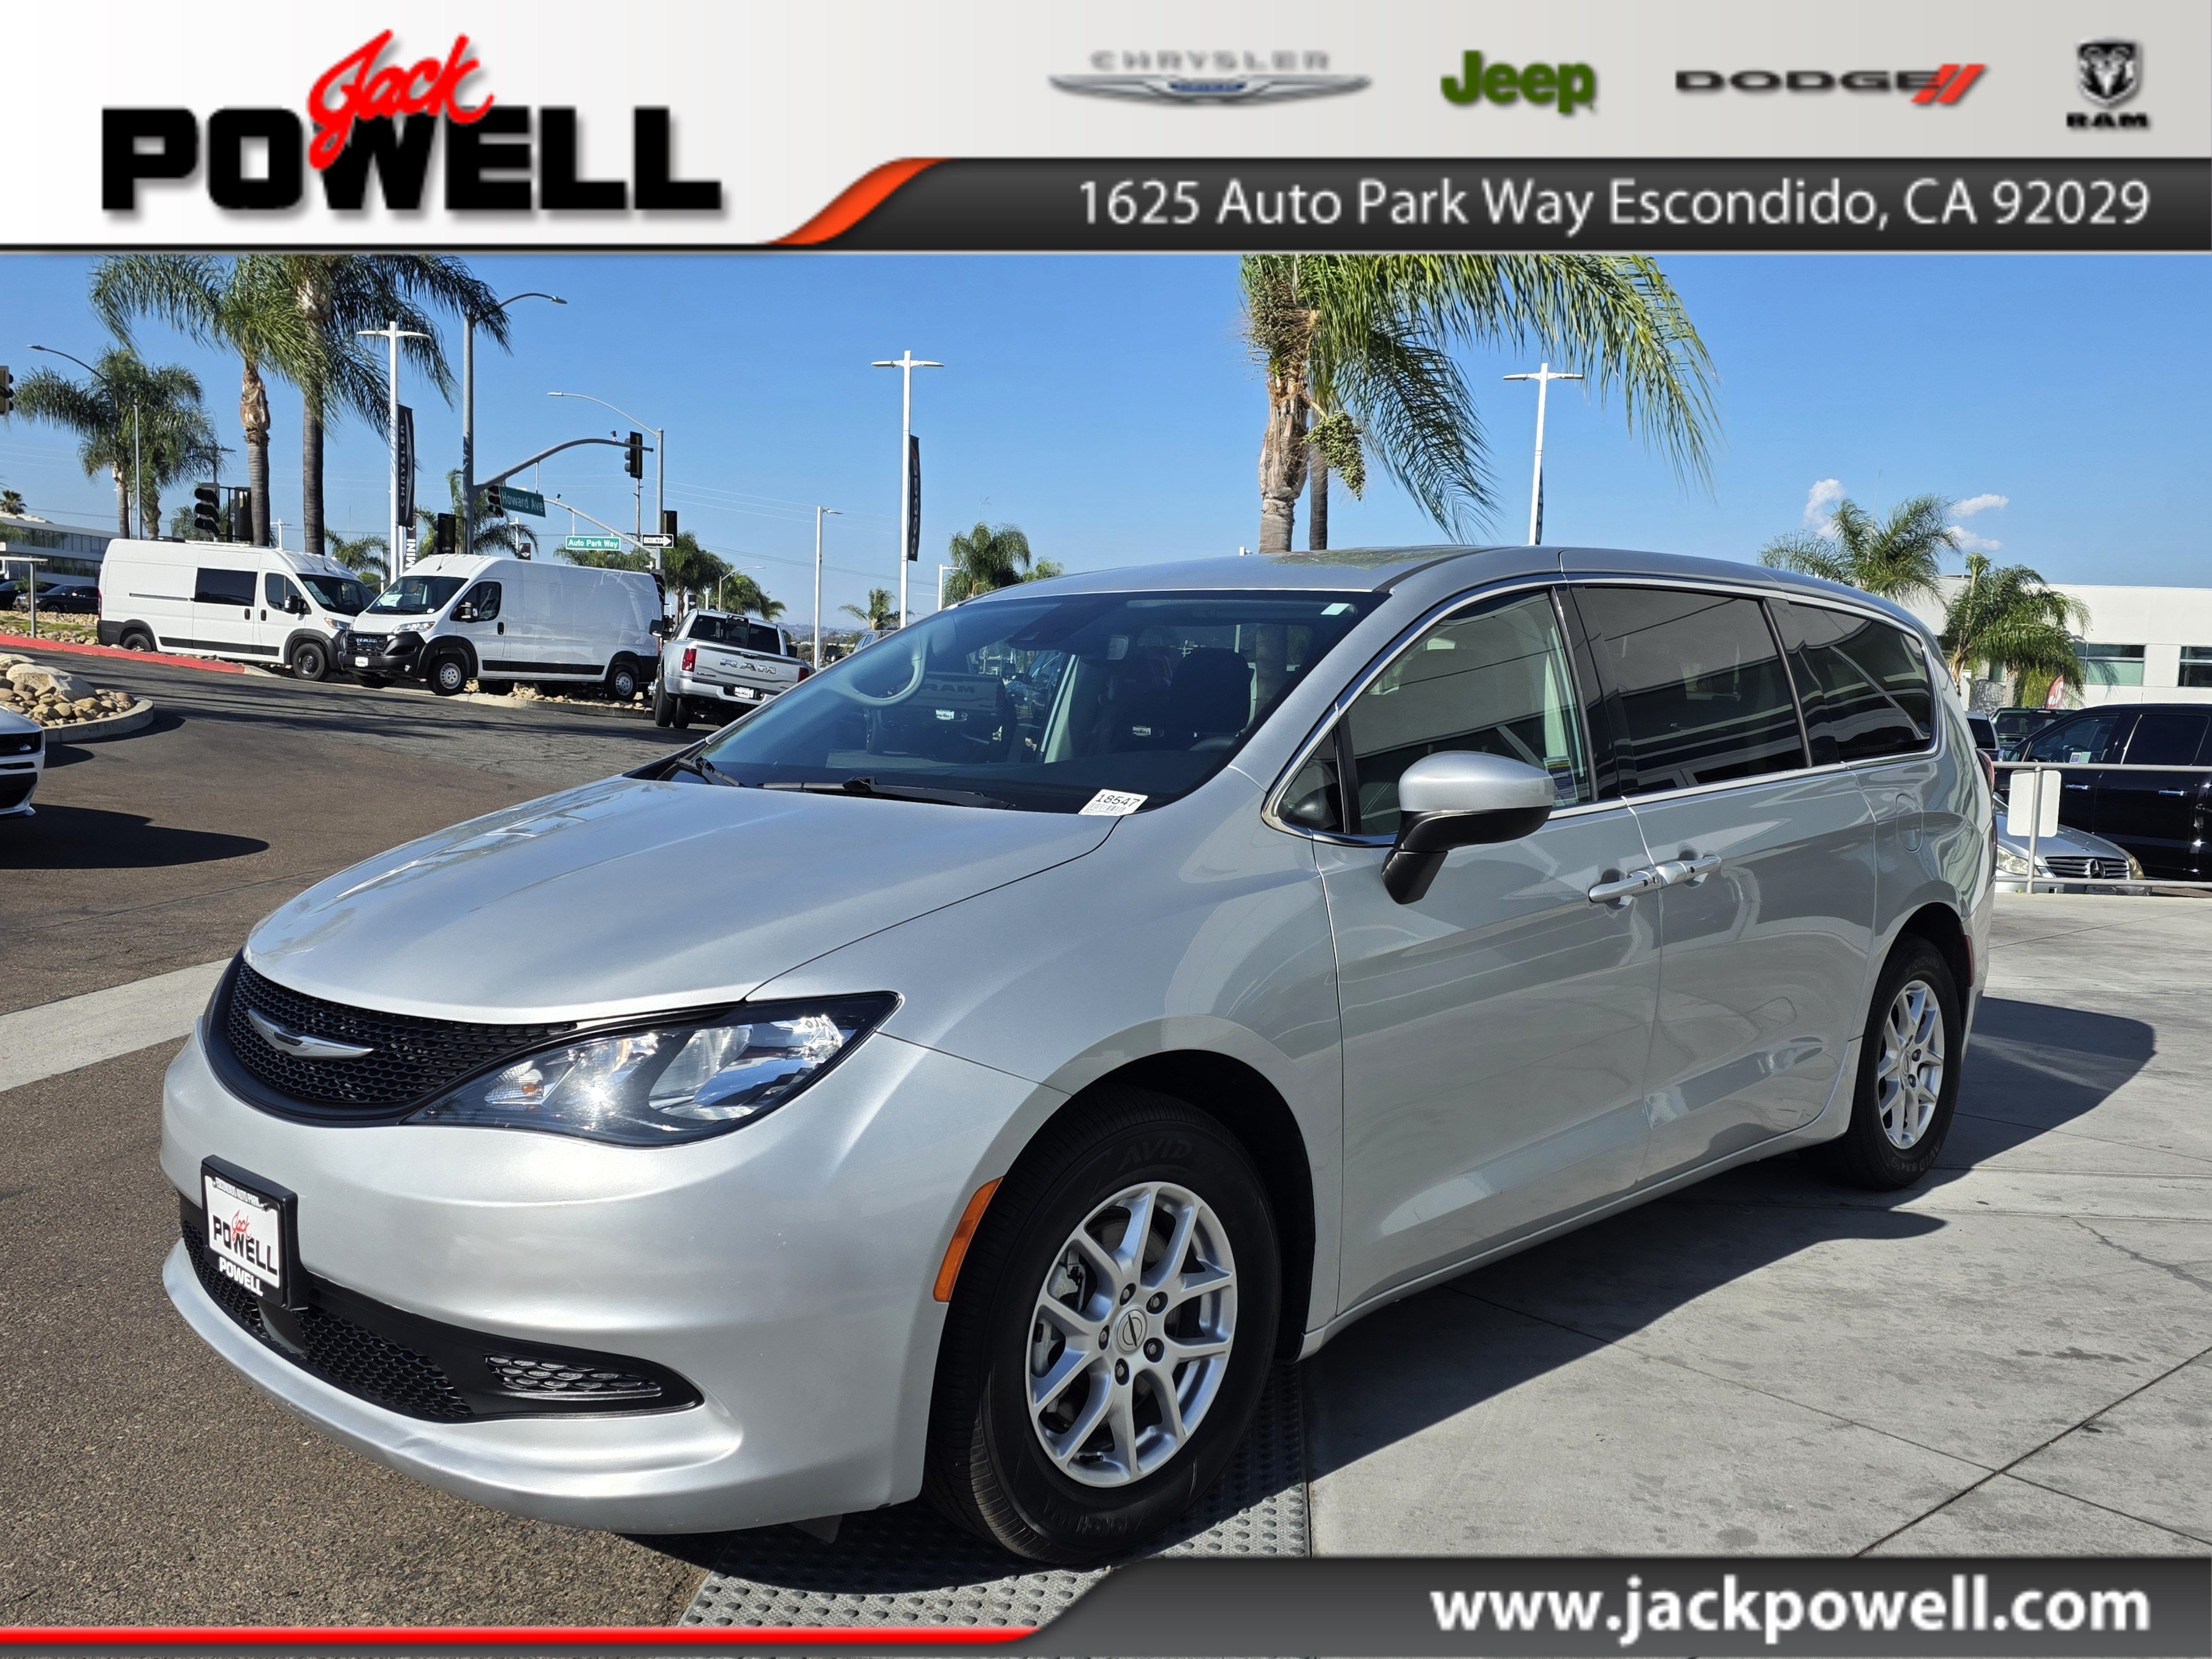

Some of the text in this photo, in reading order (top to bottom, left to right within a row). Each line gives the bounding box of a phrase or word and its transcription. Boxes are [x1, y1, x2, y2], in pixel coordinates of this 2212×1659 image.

[501, 491, 544, 512] Howard Ave
[406, 538, 416, 568] MINI
[604, 540, 618, 549] Way
[719, 658, 776, 674] RAM
[1096, 794, 1140, 807] 18547
[1117, 1139, 1192, 1172] AVID
[231, 1209, 252, 1242] Jack
[213, 1214, 278, 1277] POWELL
[219, 1256, 263, 1297] POWELL
